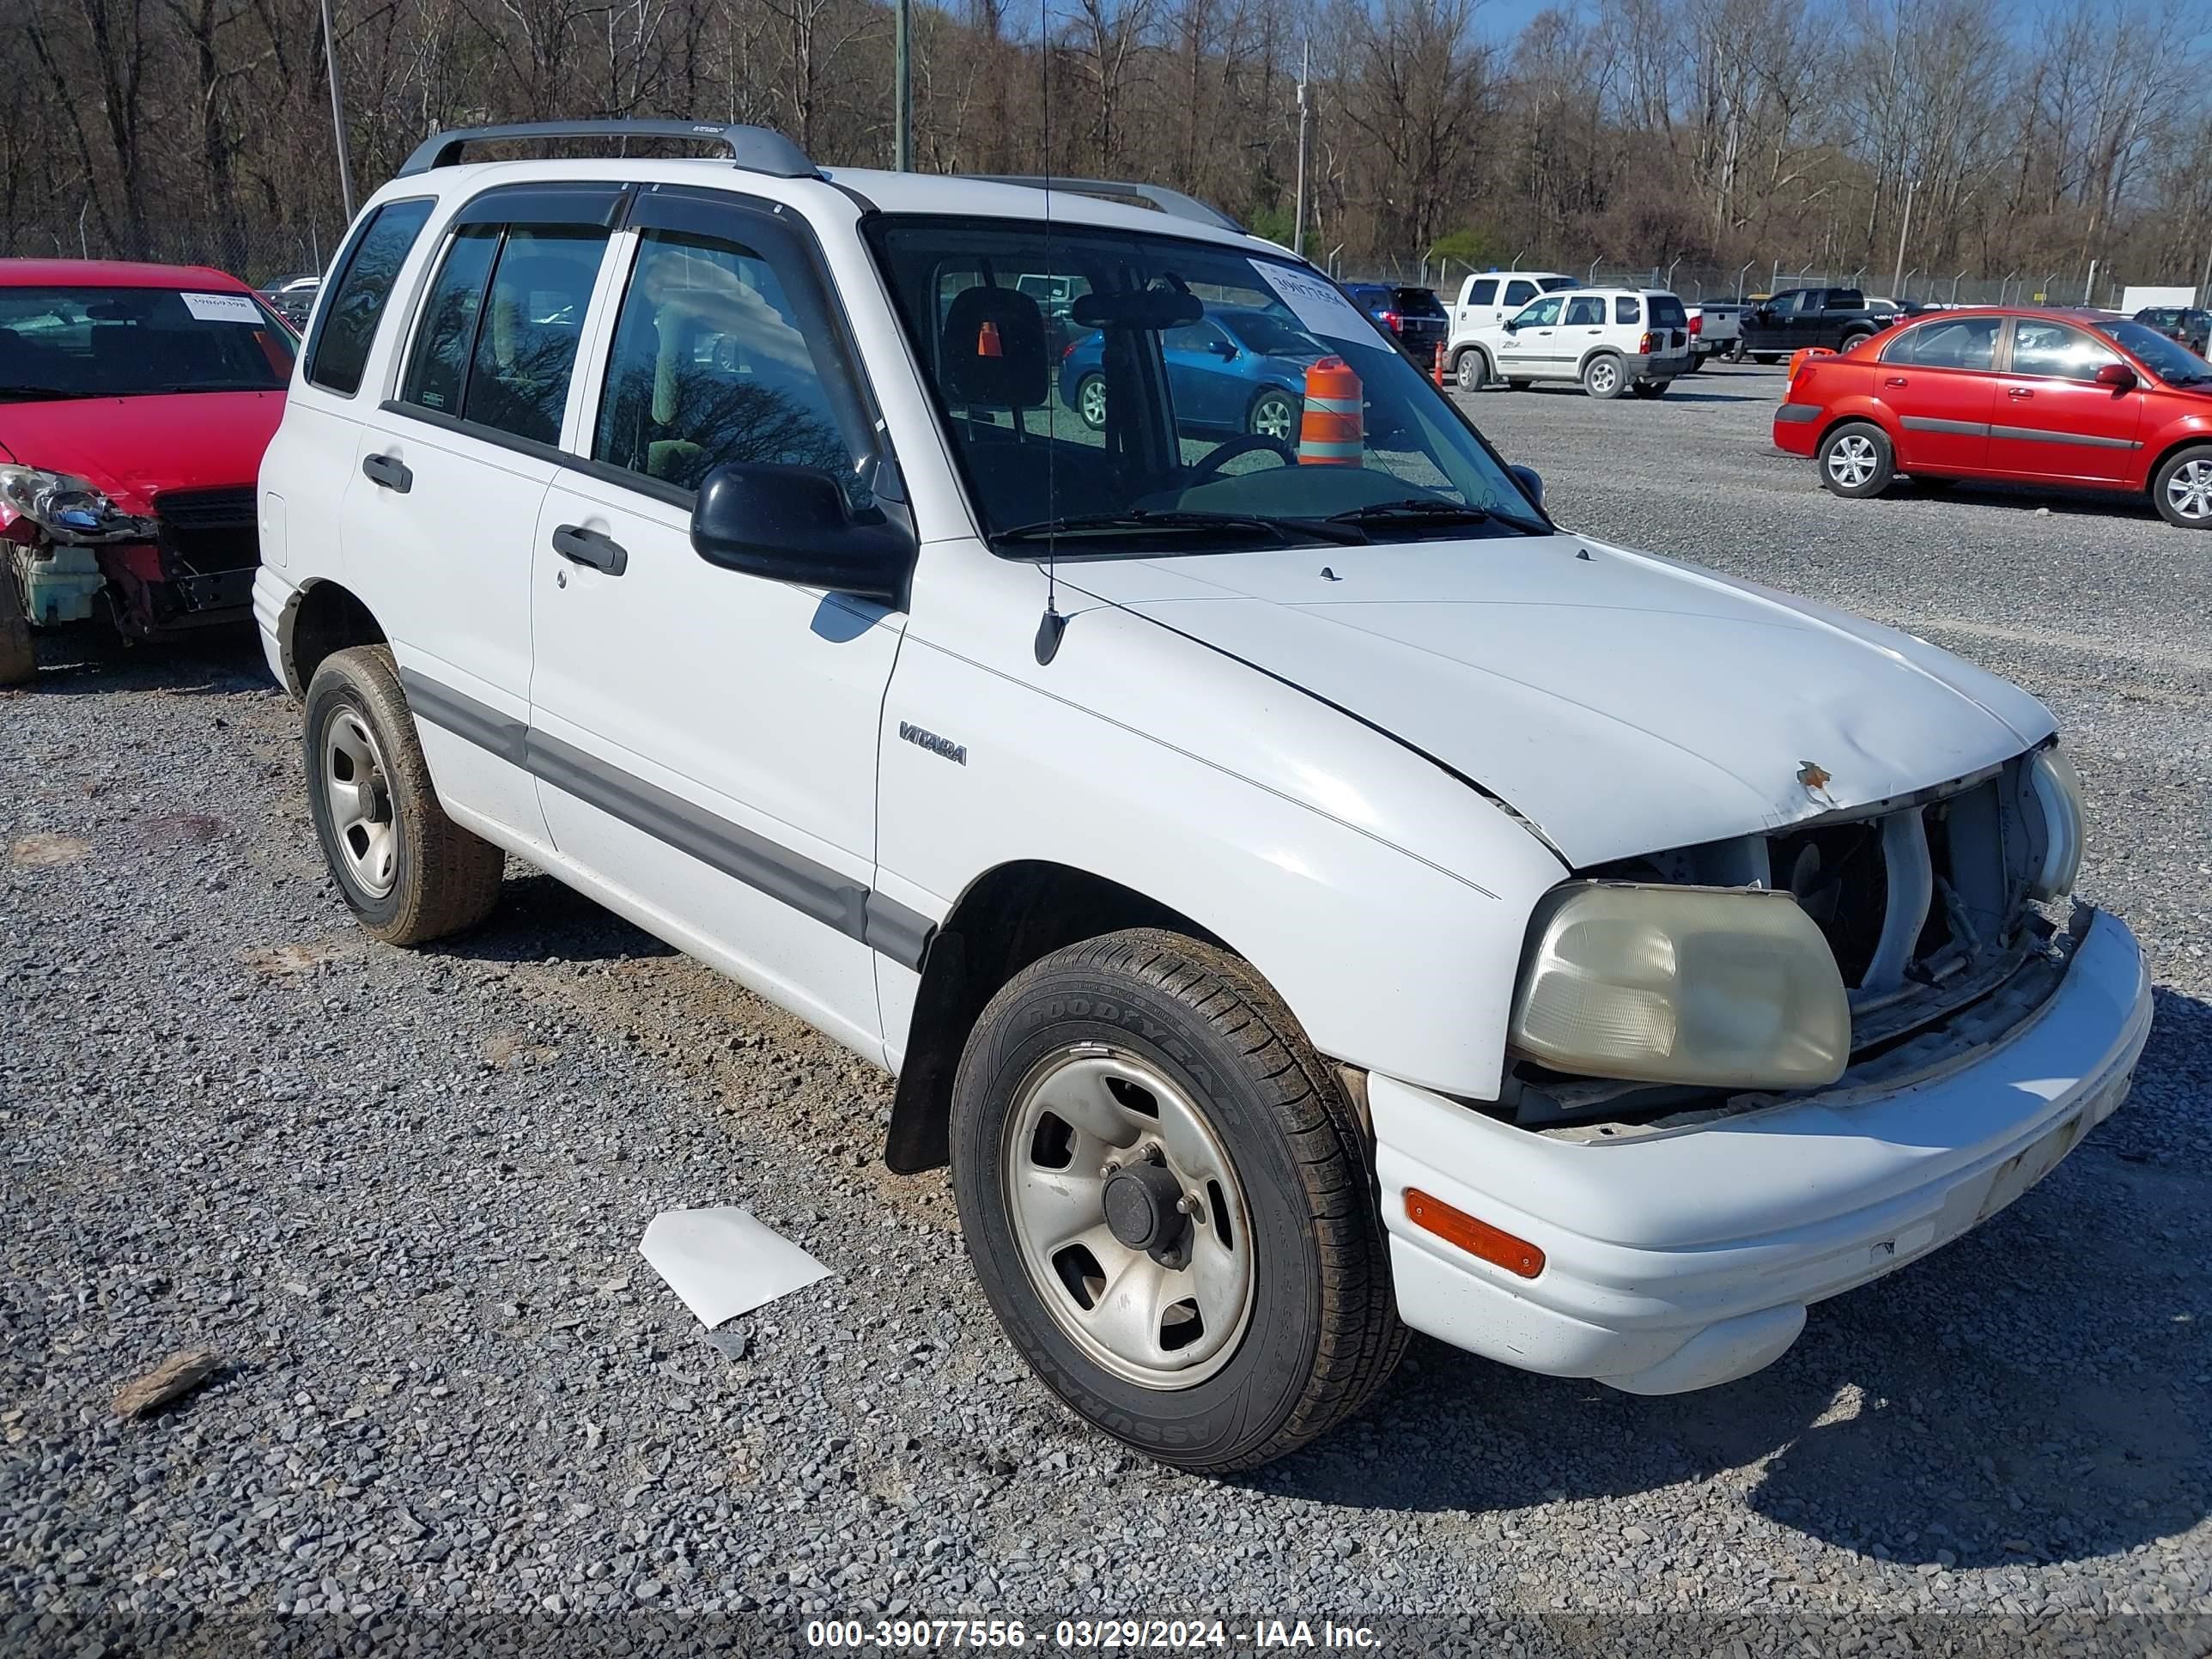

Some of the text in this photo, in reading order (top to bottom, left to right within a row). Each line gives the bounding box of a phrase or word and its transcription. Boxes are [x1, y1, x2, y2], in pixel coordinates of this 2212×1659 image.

[1273, 276, 1347, 309] 39077556
[899, 720, 968, 767] VITARA
[1023, 997, 1242, 1127] GOODYEAR
